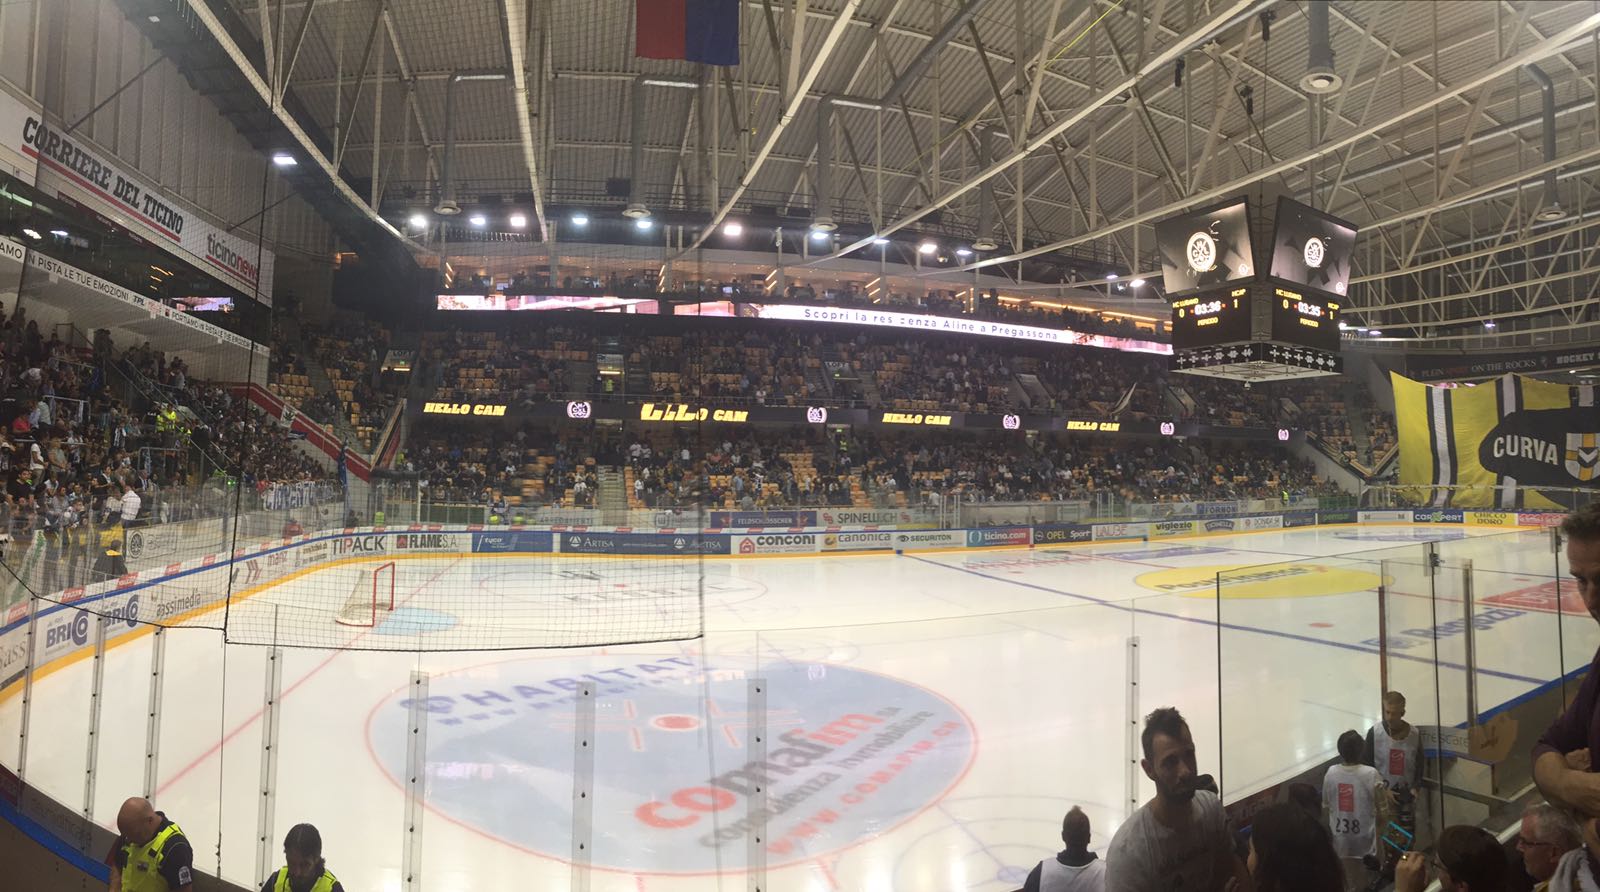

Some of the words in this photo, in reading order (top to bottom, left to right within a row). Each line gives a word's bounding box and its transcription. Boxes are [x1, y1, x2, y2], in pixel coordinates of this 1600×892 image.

[23, 117, 112, 190] CORRIERE
[113, 175, 140, 209] DEL
[143, 193, 184, 235] TICINO
[26, 254, 35, 265] N
[38, 257, 63, 276] PISTA
[64, 268, 74, 279] LE
[76, 273, 91, 286] TUE
[93, 279, 129, 301] EMOZIONI
[1194, 300, 1221, 315] 03:36
[1233, 299, 1238, 308] 1
[1282, 299, 1289, 309] 0
[1298, 302, 1321, 317] 03:35
[1179, 308, 1185, 318] 0
[1329, 311, 1334, 320] 1
[805, 309, 849, 321] Scopri
[855, 312, 867, 322] la
[944, 320, 974, 331] Aline
[992, 325, 1058, 340] Pregassona
[1556, 352, 1594, 364] HOCKEY
[1472, 364, 1485, 373] ON
[1487, 362, 1503, 371] THE
[1505, 359, 1537, 370] ROCKS
[424, 403, 470, 415] HELLO
[473, 404, 506, 416] CAM
[713, 409, 748, 422] CAM
[925, 415, 951, 426] CAM
[1099, 422, 1120, 432] CAM
[1493, 434, 1559, 465] CURVA
[756, 535, 815, 546] conconi
[838, 533, 891, 543] canonica
[911, 534, 952, 543] SECURITON
[984, 531, 1026, 541] ticino.com
[1047, 531, 1066, 541] OPEL
[1070, 529, 1091, 540] Sport
[332, 535, 385, 555] TIPACK
[46, 608, 89, 649] BRICO
[1335, 818, 1361, 834] 238
